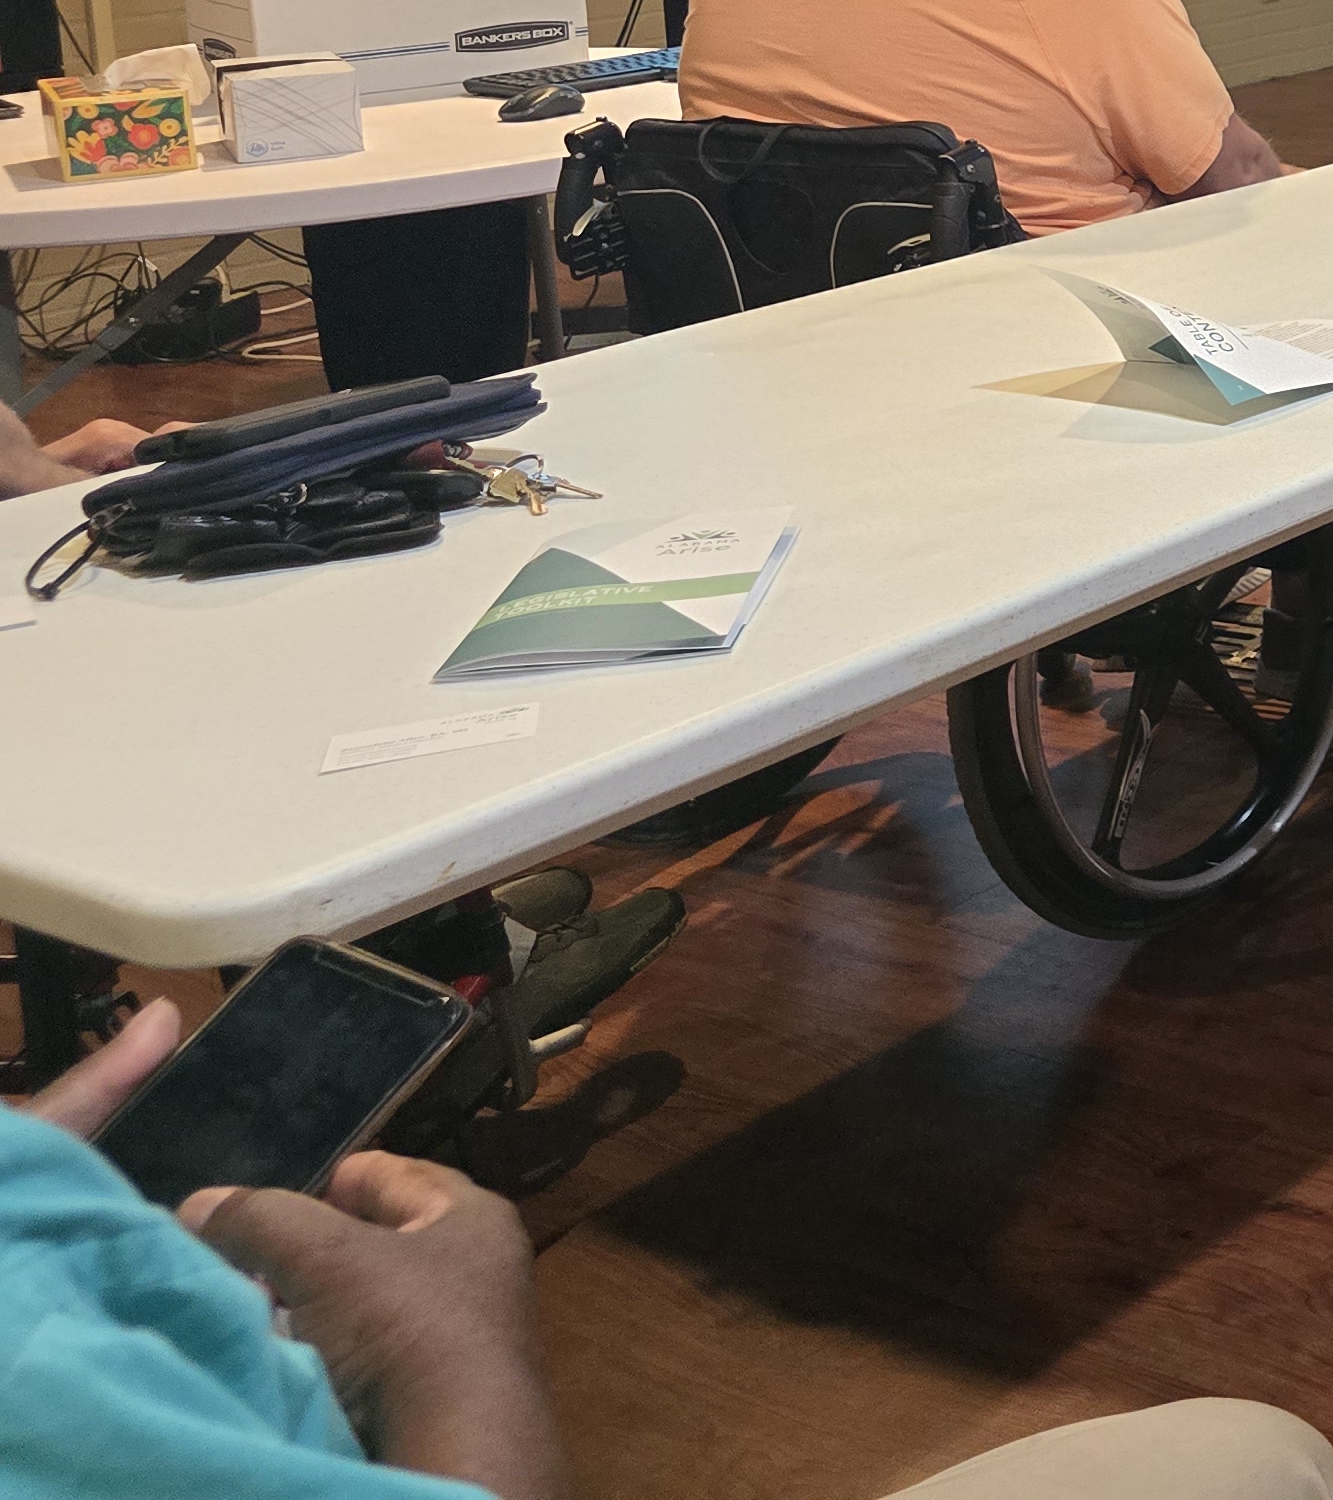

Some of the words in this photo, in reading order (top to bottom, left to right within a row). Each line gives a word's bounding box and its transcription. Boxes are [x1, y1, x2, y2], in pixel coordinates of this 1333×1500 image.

[462, 30, 531, 46] BANKERS
[532, 26, 563, 39] BOX
[1180, 320, 1218, 356] TABLE
[495, 596, 599, 620] TOOLKIT
